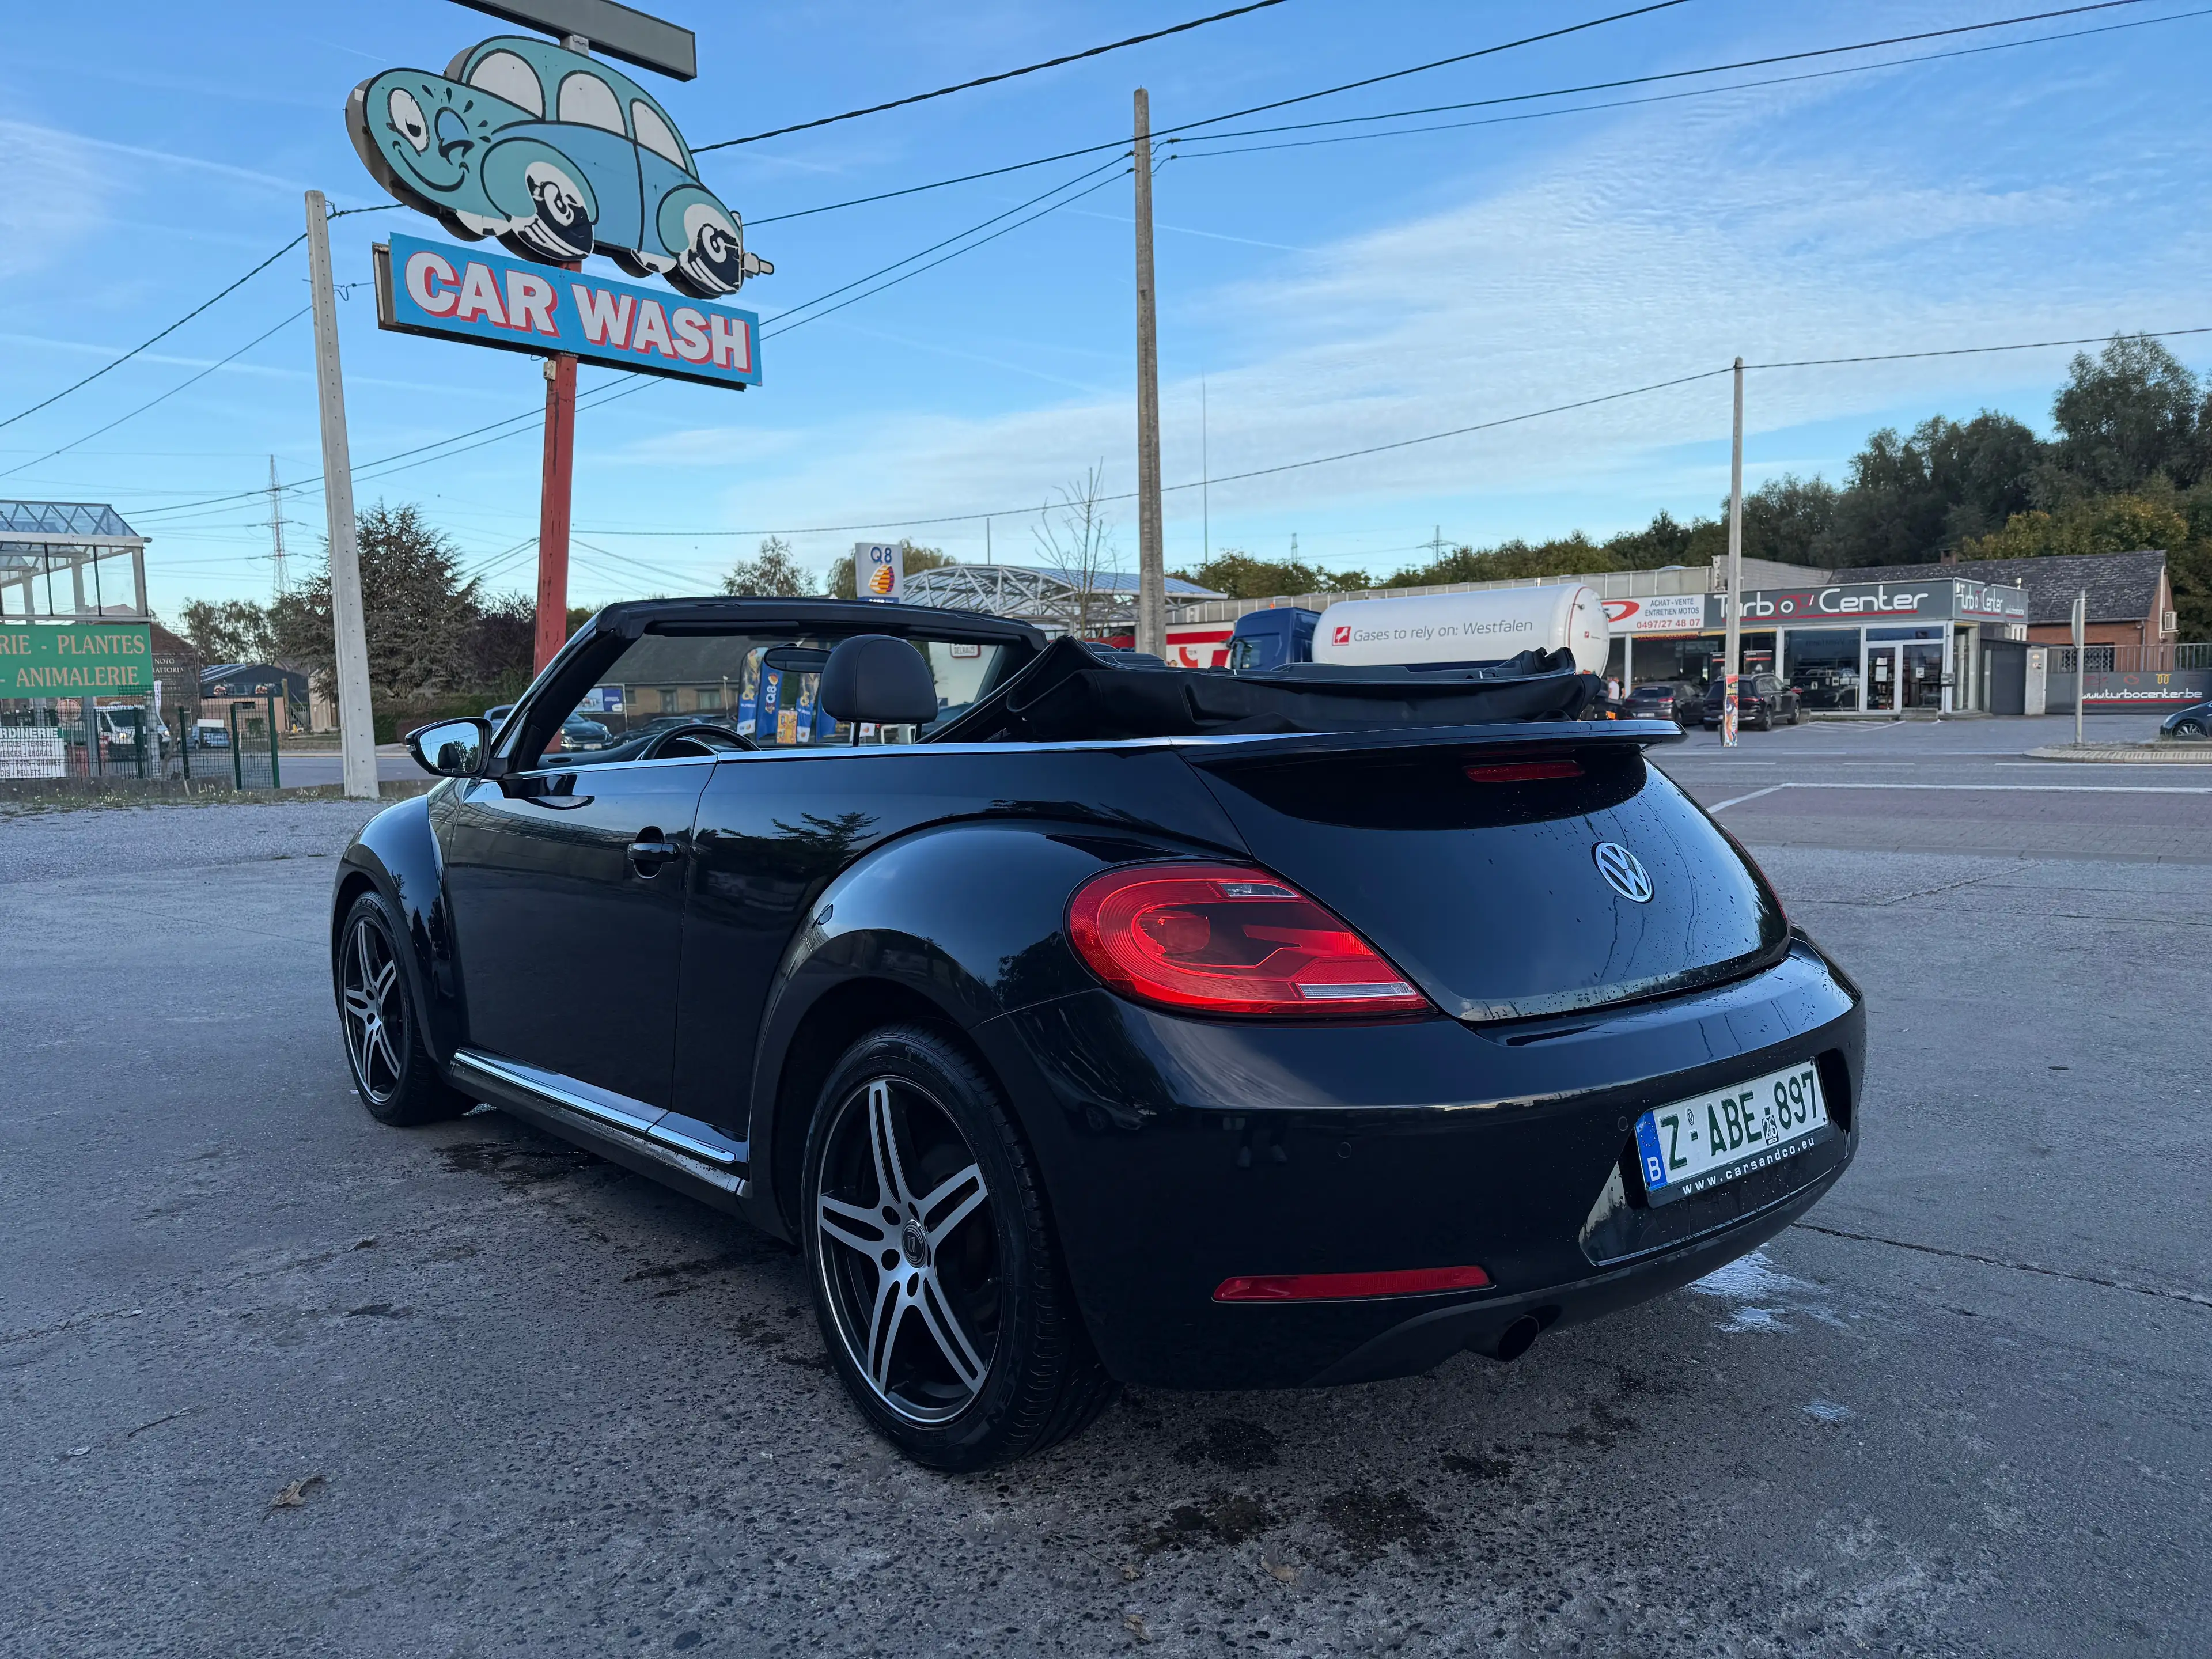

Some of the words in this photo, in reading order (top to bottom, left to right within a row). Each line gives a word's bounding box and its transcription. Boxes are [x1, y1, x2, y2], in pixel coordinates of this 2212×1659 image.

[406, 251, 560, 338] CAR
[571, 284, 752, 374] WASH
[870, 547, 892, 565] Q8
[1650, 600, 1670, 608] ACHAT
[1675, 597, 1694, 605] VENTE
[1819, 585, 1928, 613] Center
[1645, 608, 1676, 616] ENTRETIEN
[1354, 629, 1389, 642] Gases
[1394, 628, 1407, 639] to
[1411, 626, 1434, 641] rely
[1438, 627, 1459, 637] on:
[1463, 619, 1533, 635] Westfalen
[1637, 620, 1672, 629] 0497/27
[1675, 619, 1686, 627] 48
[1689, 618, 1700, 627] 07
[57, 635, 145, 654] PLANTES
[16, 666, 139, 687] ANIMALERIE
[766, 685, 777, 703] Q8
[2082, 688, 2202, 699] www.turbocenter.be
[1647, 1156, 1662, 1182] B
[1683, 1137, 1815, 1195] www.carsandco.eu
